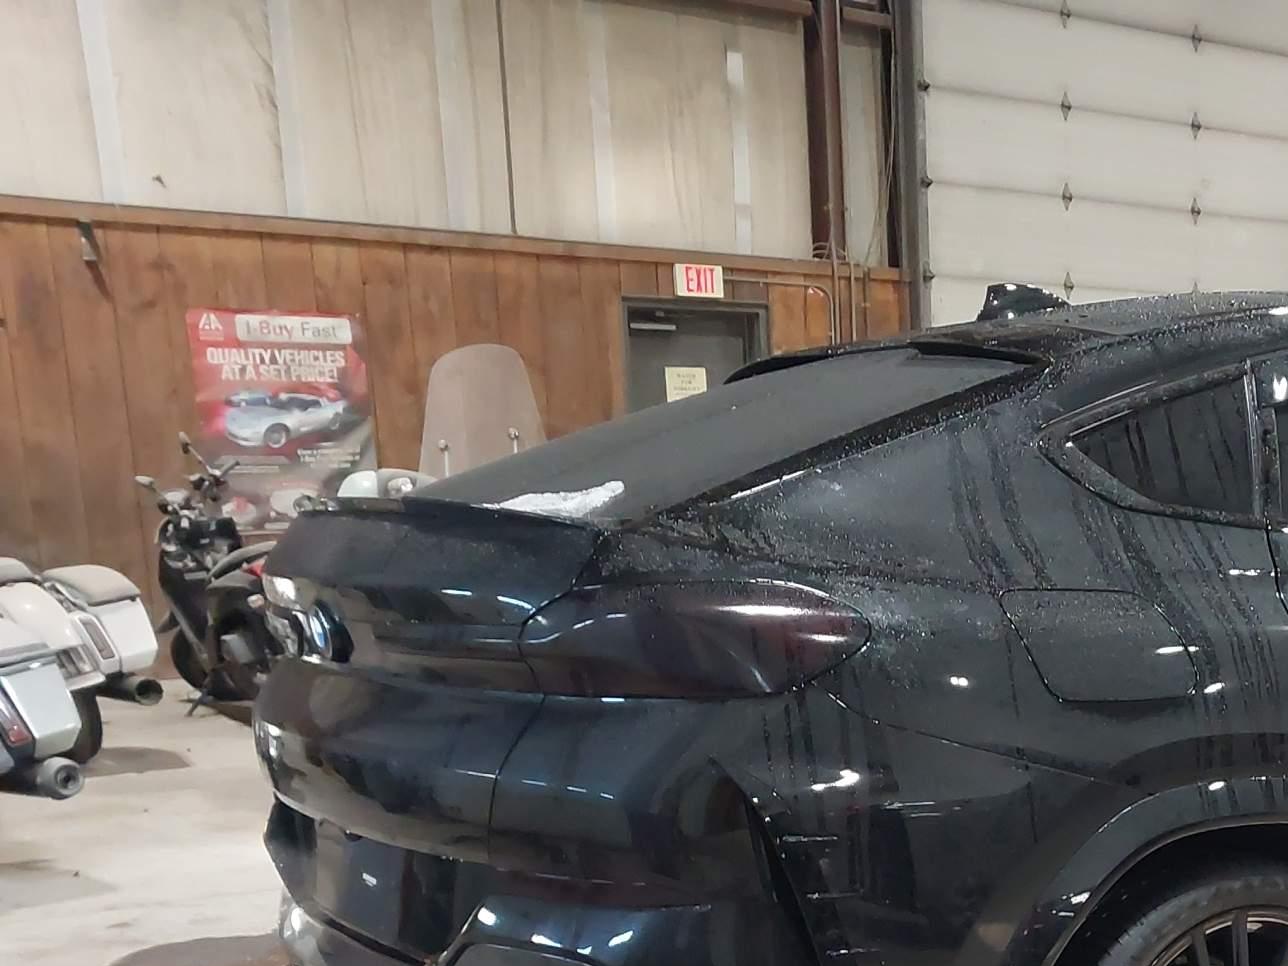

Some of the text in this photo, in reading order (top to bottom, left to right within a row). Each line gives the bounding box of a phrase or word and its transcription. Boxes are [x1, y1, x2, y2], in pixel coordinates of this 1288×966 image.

[685, 266, 716, 293] EXIT
[300, 321, 338, 338] Fast
[206, 347, 345, 367] QUALITY VEHICLES
[221, 365, 338, 383] AT A SET PRICE!
